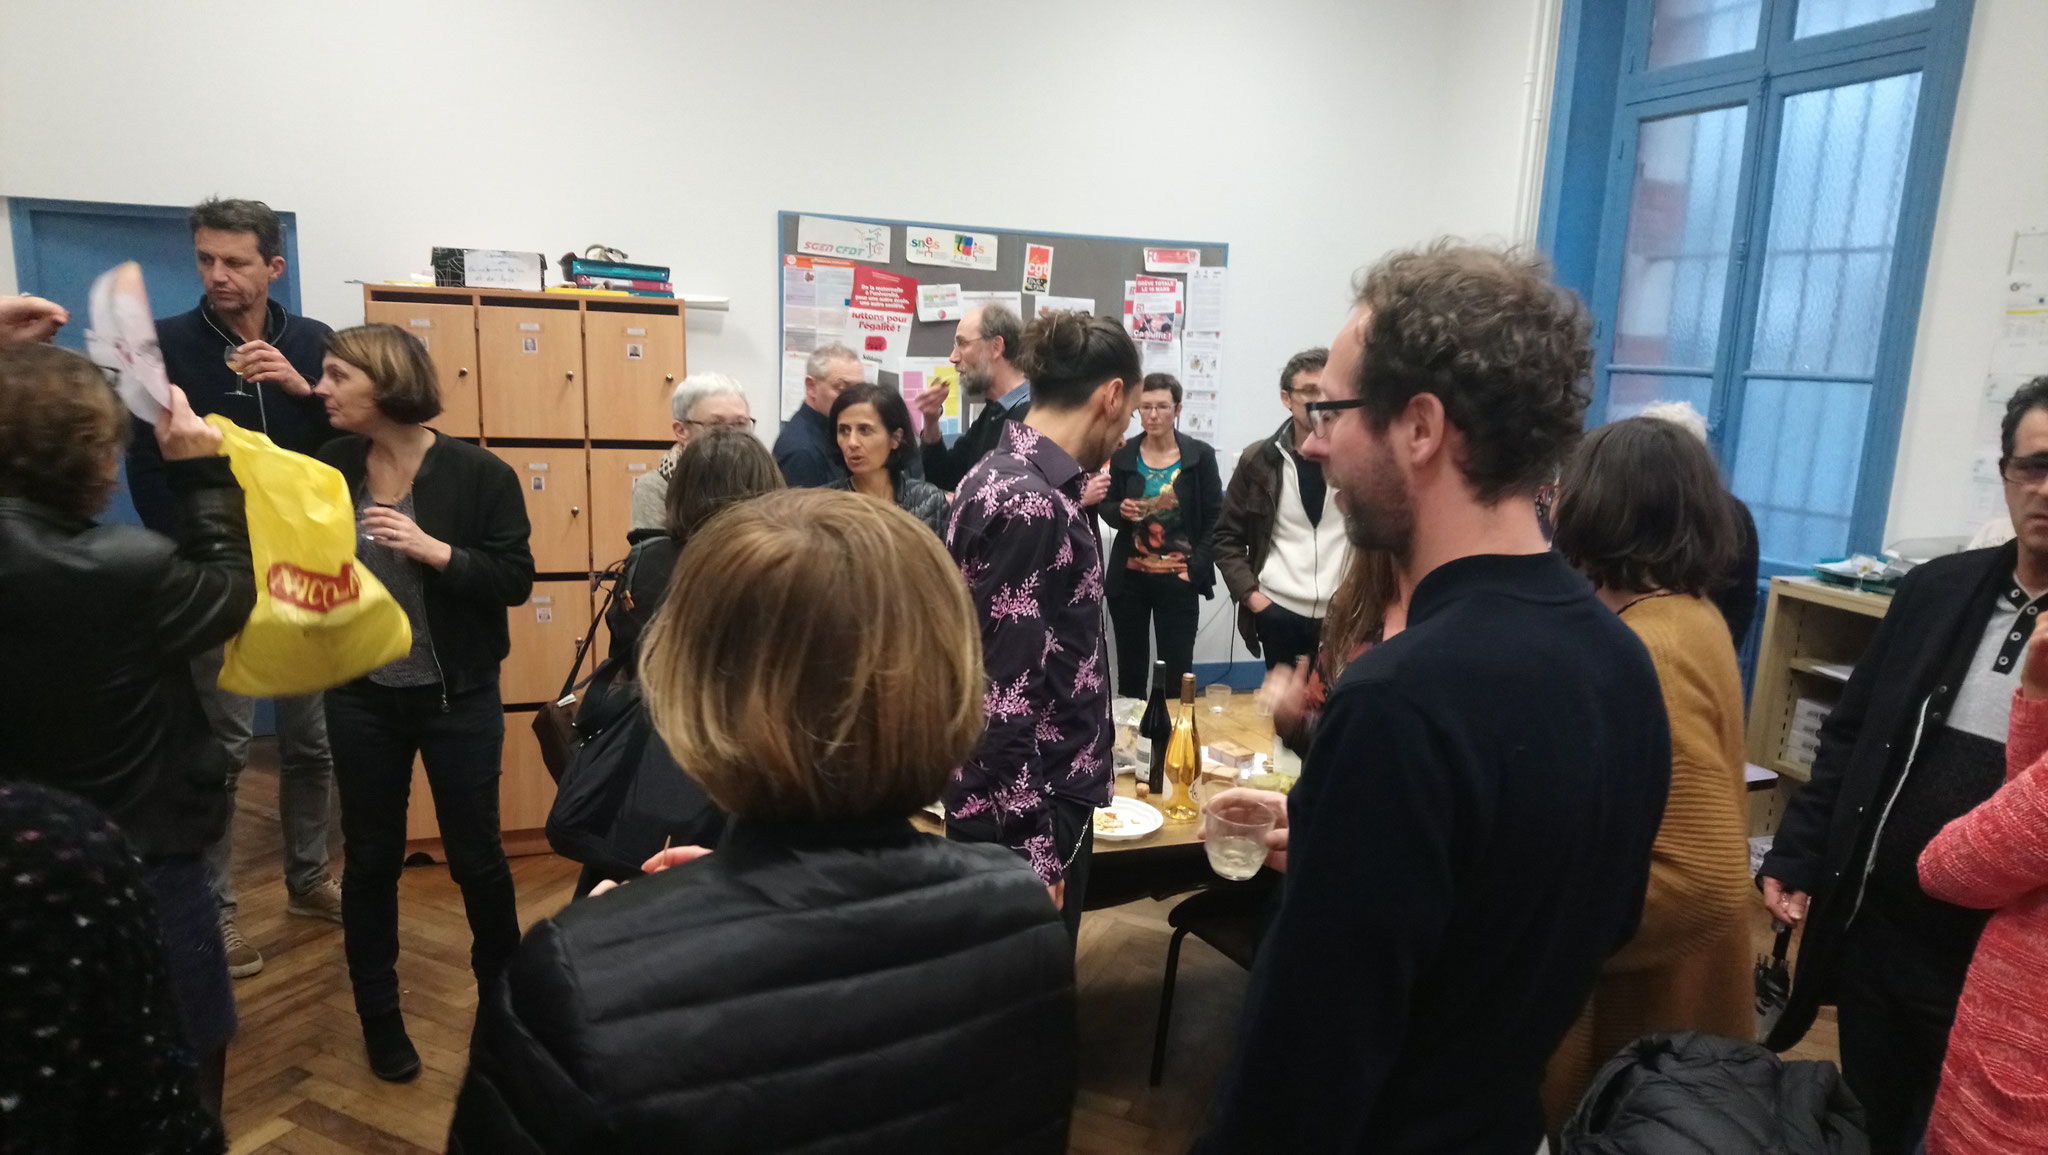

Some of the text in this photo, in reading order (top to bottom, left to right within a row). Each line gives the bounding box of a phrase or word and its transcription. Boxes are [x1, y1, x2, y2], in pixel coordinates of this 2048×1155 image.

[804, 241, 864, 256] SGEN CFDT
[1029, 262, 1048, 278] cgt
[886, 315, 907, 324] pour
[859, 321, 896, 332] l'égalité
